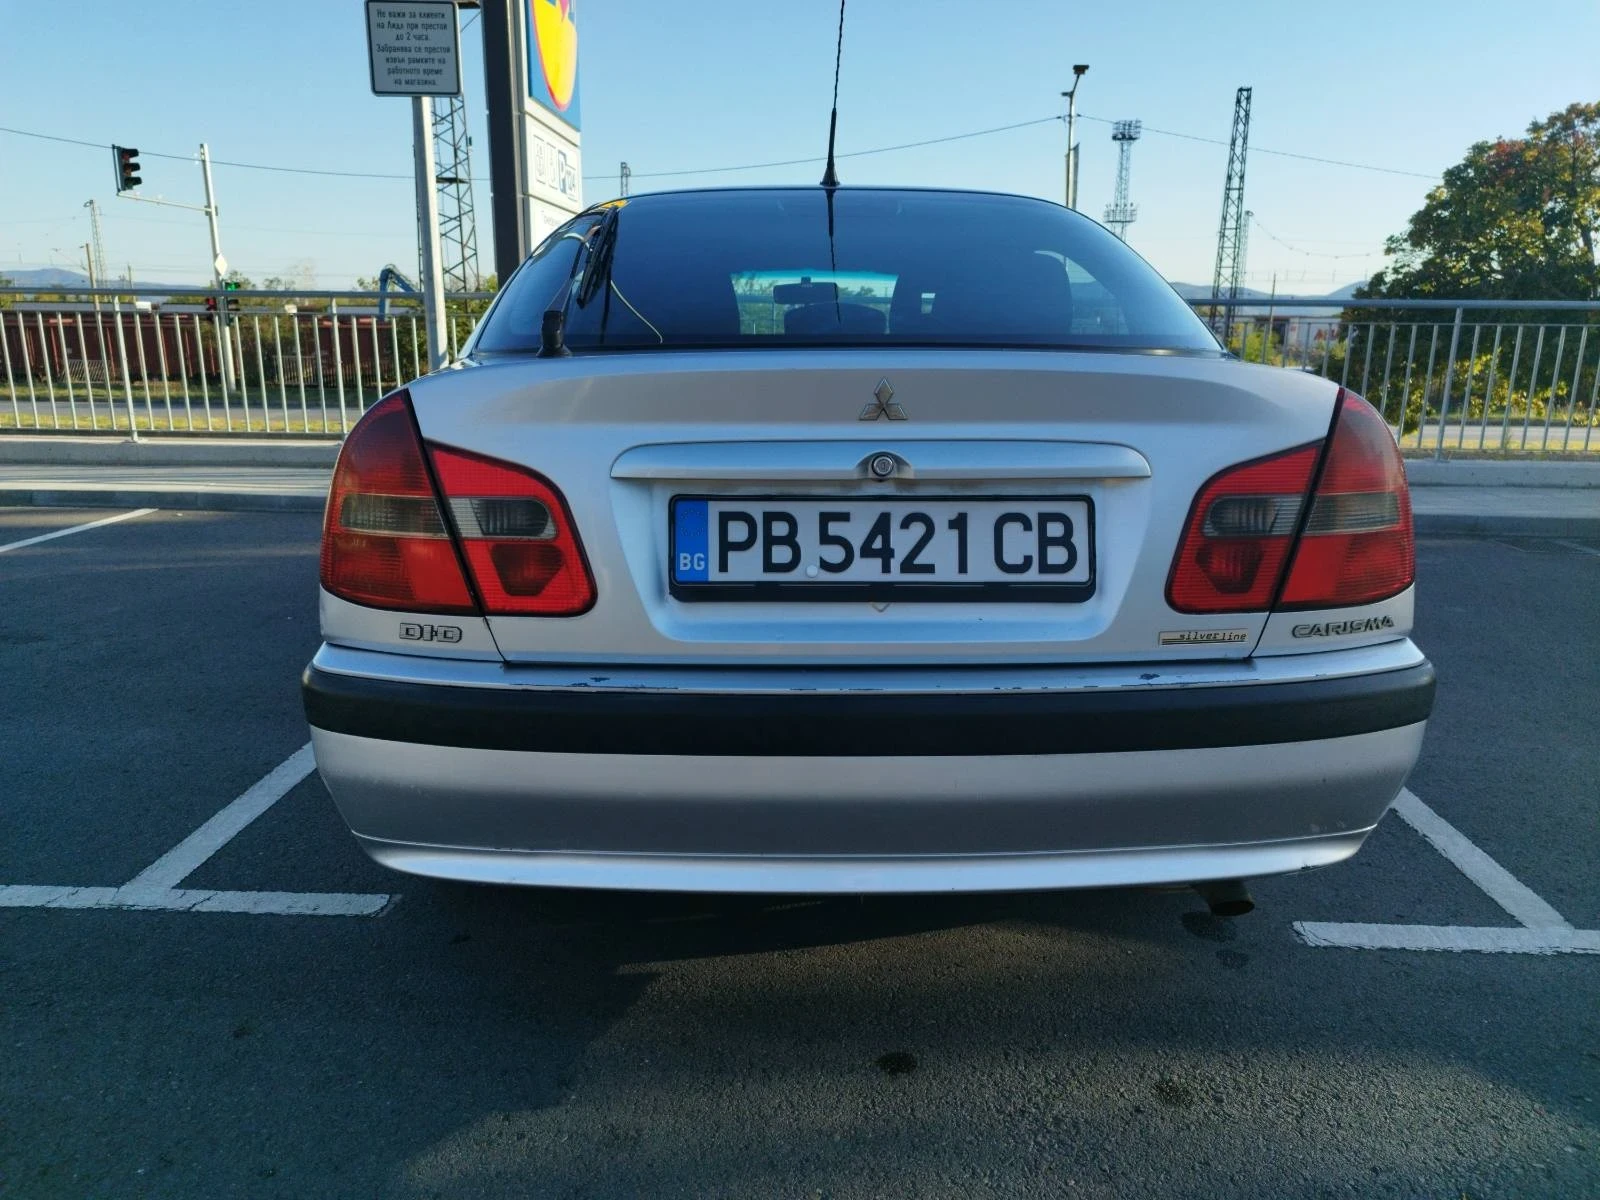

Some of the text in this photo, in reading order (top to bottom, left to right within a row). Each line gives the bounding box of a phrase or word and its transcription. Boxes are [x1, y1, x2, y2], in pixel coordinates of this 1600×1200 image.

[408, 11, 416, 19] за
[376, 22, 385, 30] на
[406, 22, 419, 31] при
[406, 32, 411, 40] 2
[718, 511, 1078, 574] PB 5421 CB
[679, 552, 705, 571] BG
[1291, 615, 1395, 639] CARISMA
